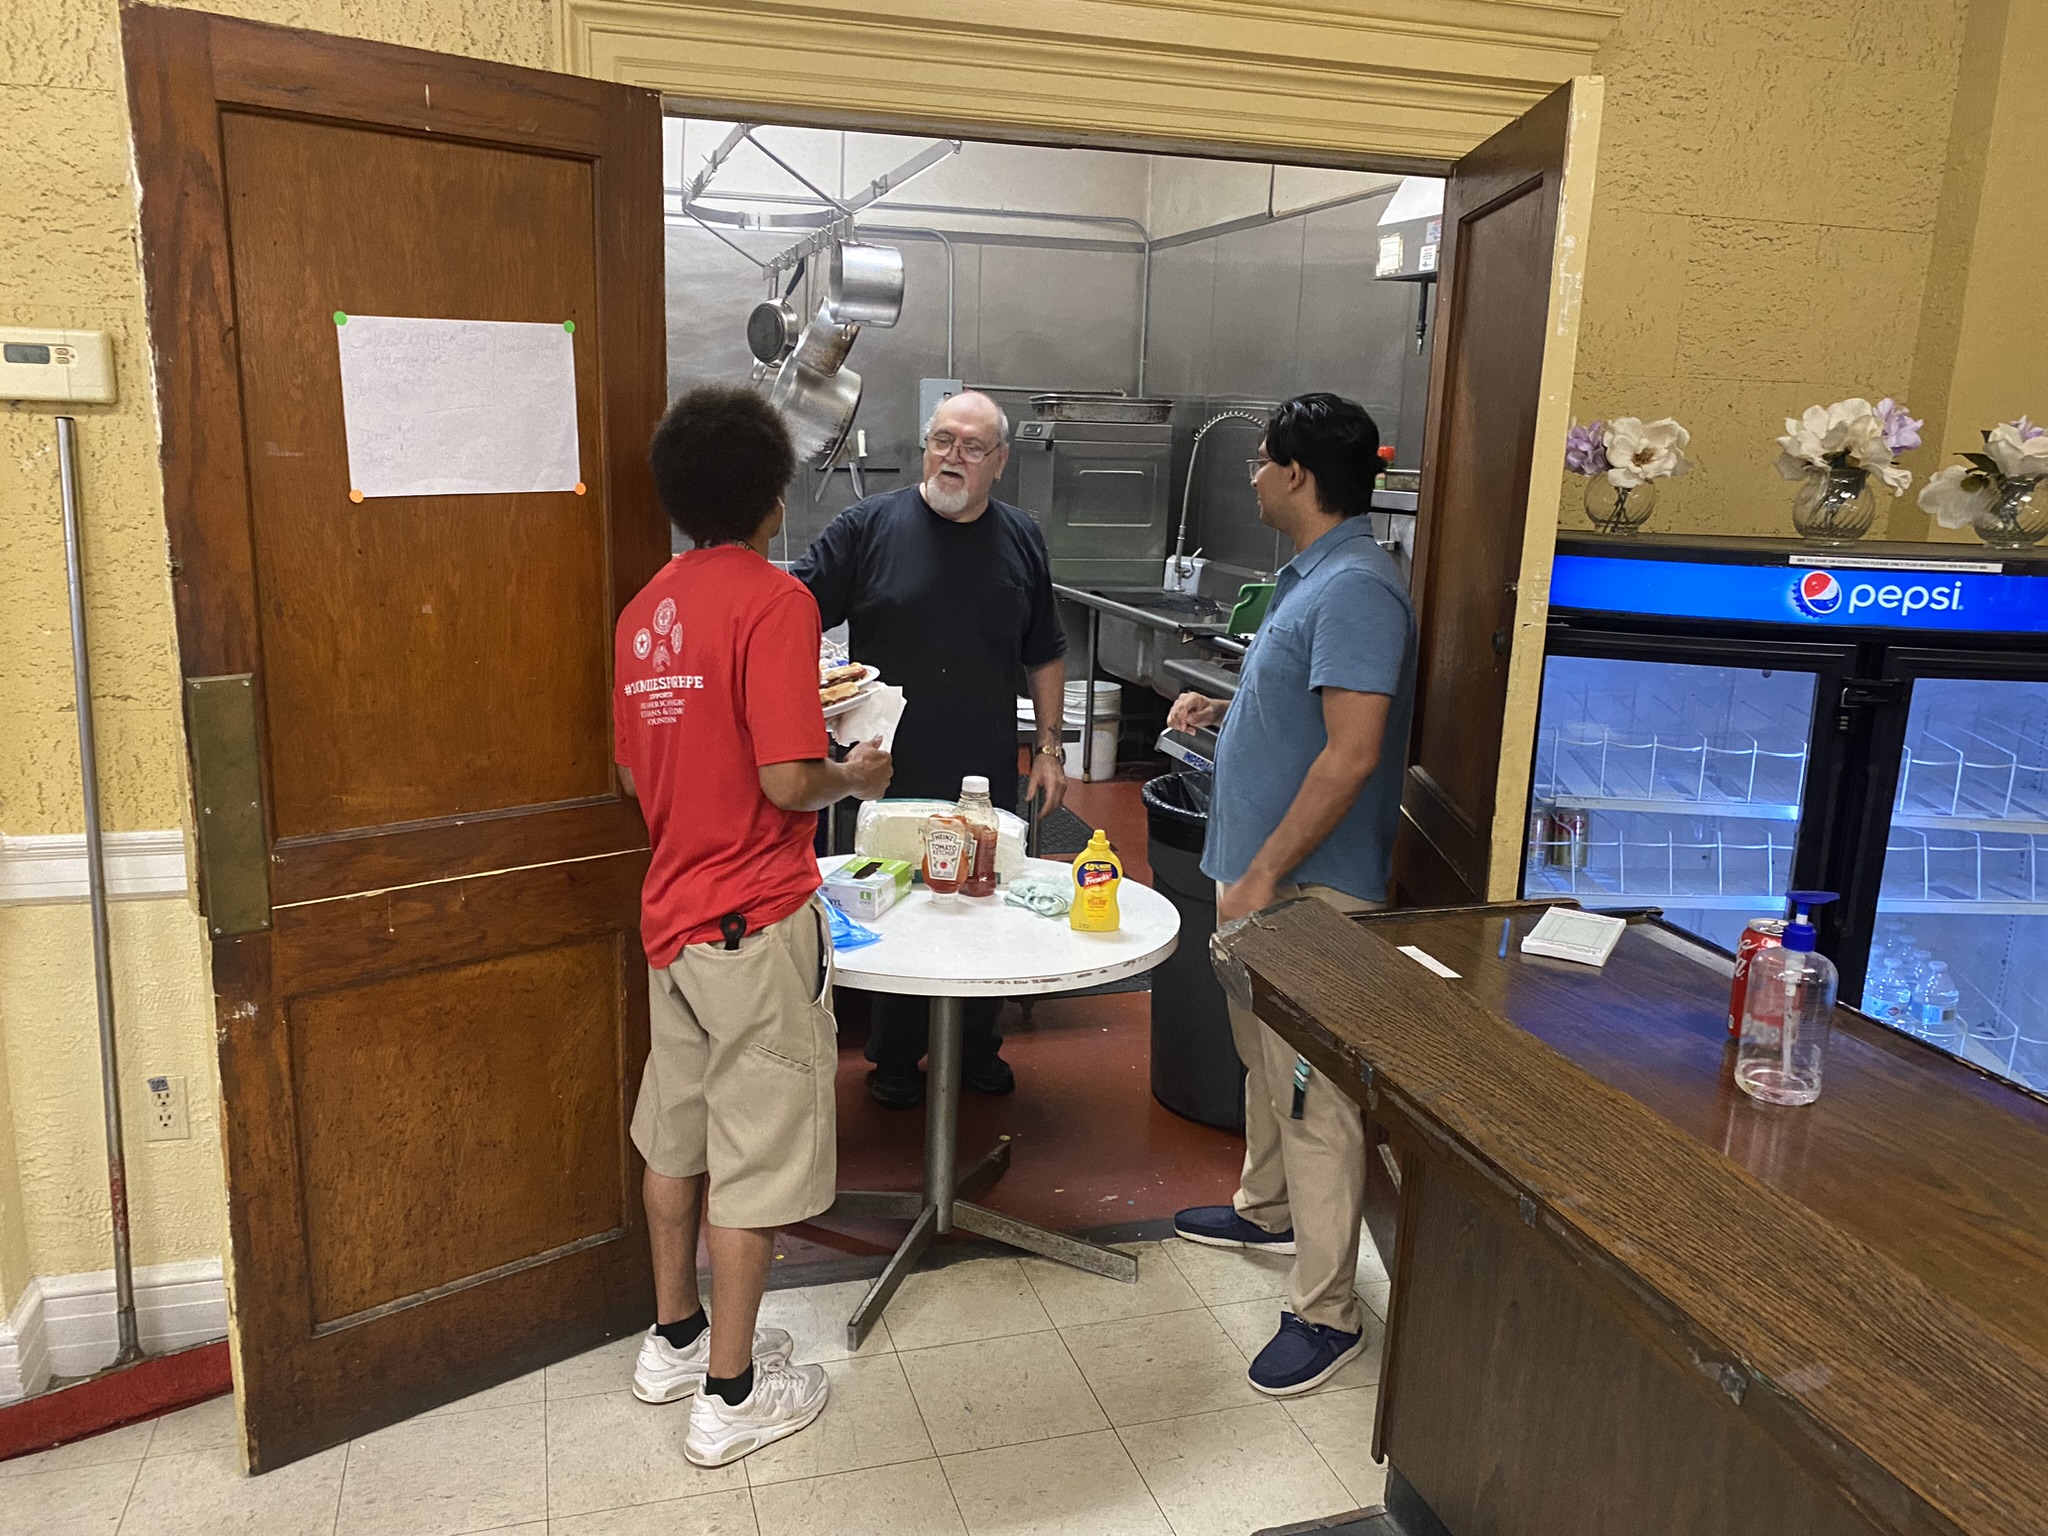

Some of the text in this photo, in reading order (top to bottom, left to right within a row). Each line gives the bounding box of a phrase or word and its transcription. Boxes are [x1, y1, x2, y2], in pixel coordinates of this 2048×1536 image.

[1848, 581, 1963, 616] pepsi
[931, 843, 957, 852] TOMATO
[827, 898, 843, 907] NYL
